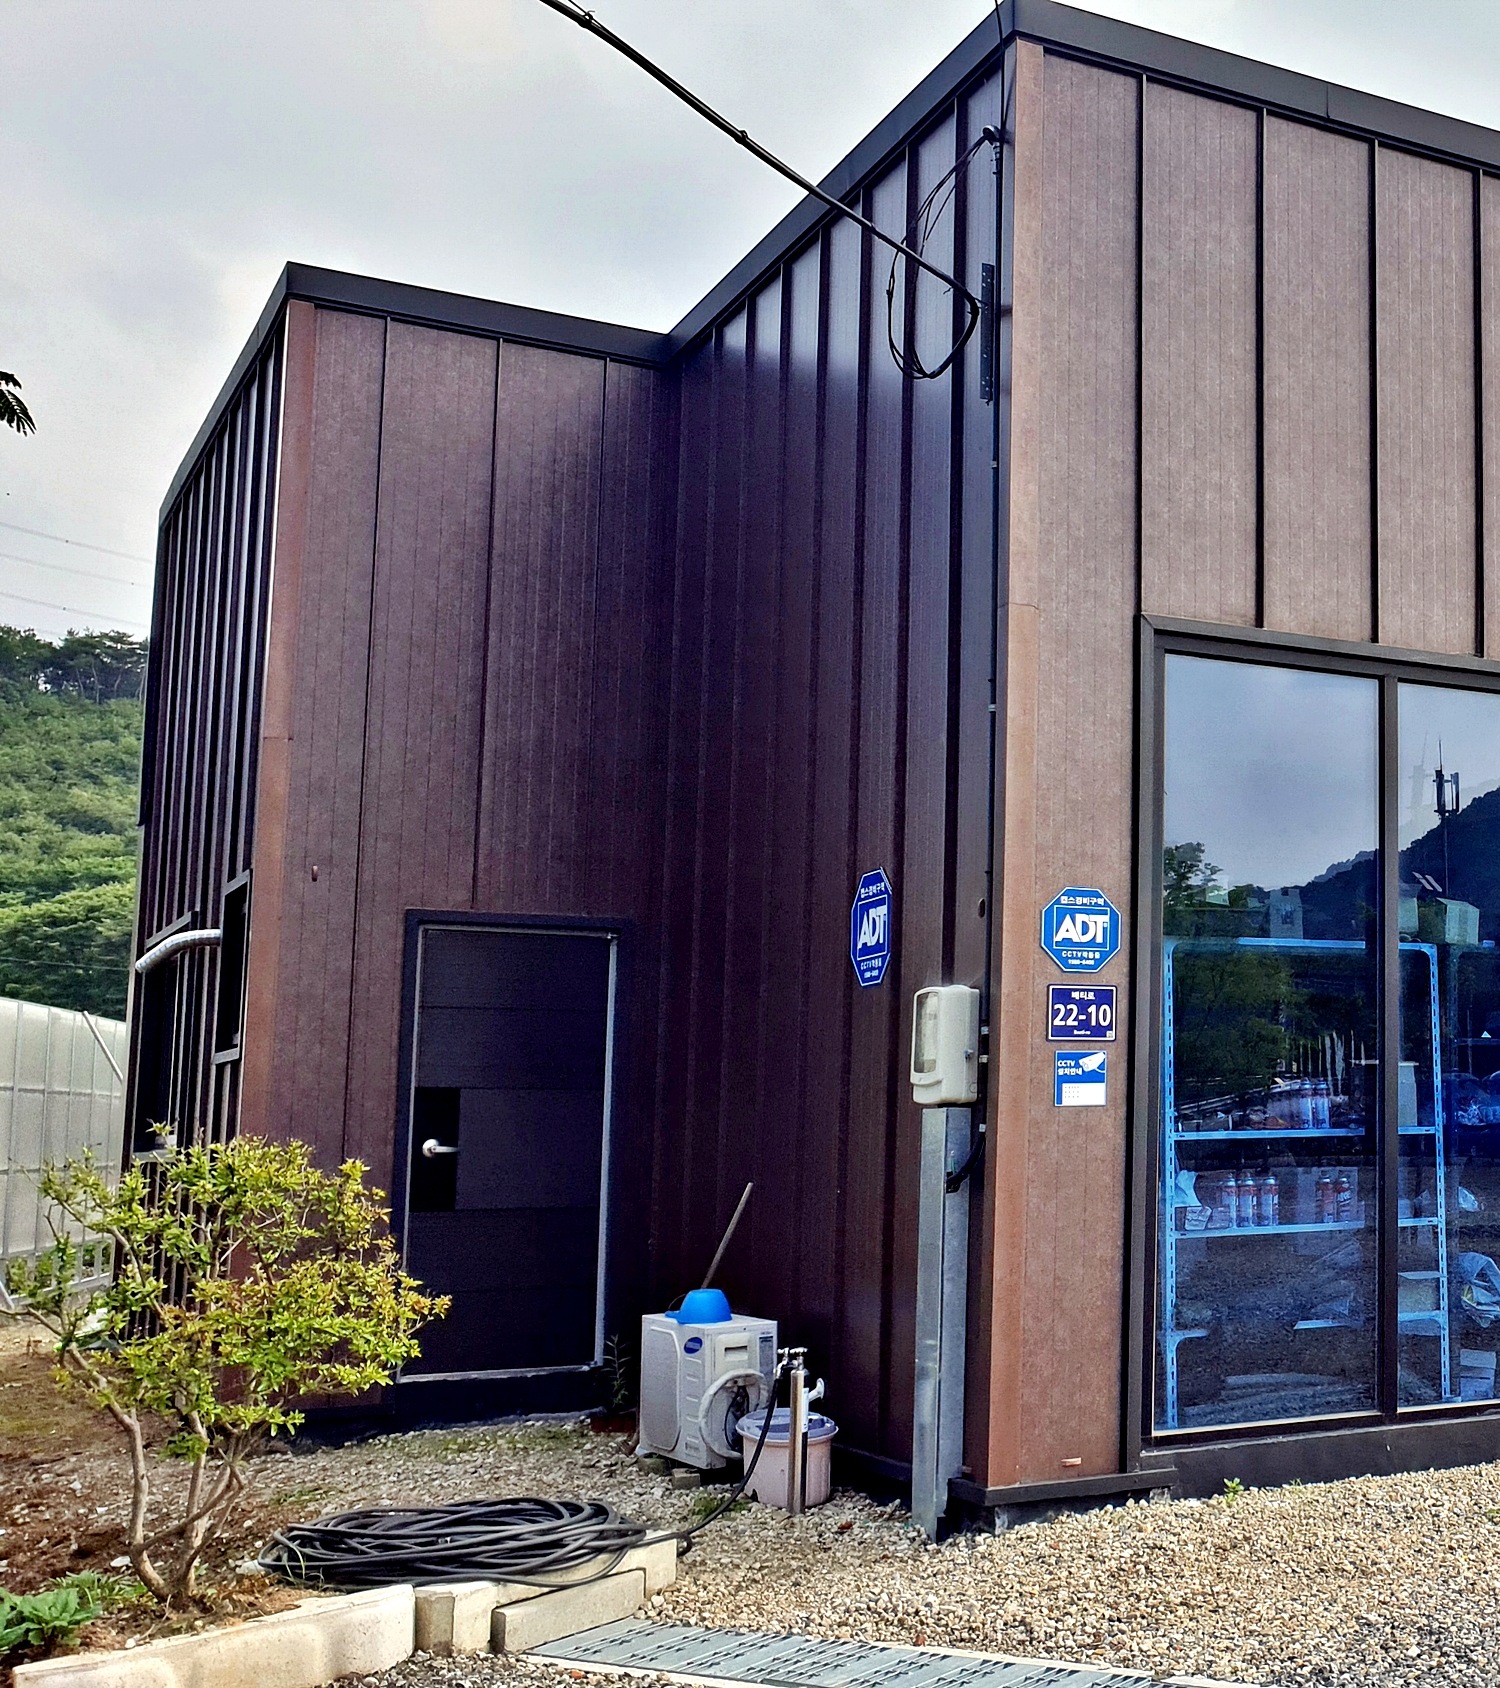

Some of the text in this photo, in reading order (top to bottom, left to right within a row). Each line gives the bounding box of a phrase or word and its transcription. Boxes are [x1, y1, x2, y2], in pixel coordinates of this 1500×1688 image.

[858, 905, 887, 949] ADT
[1055, 913, 1109, 943] ADT
[1053, 1003, 1111, 1027] 22-10
